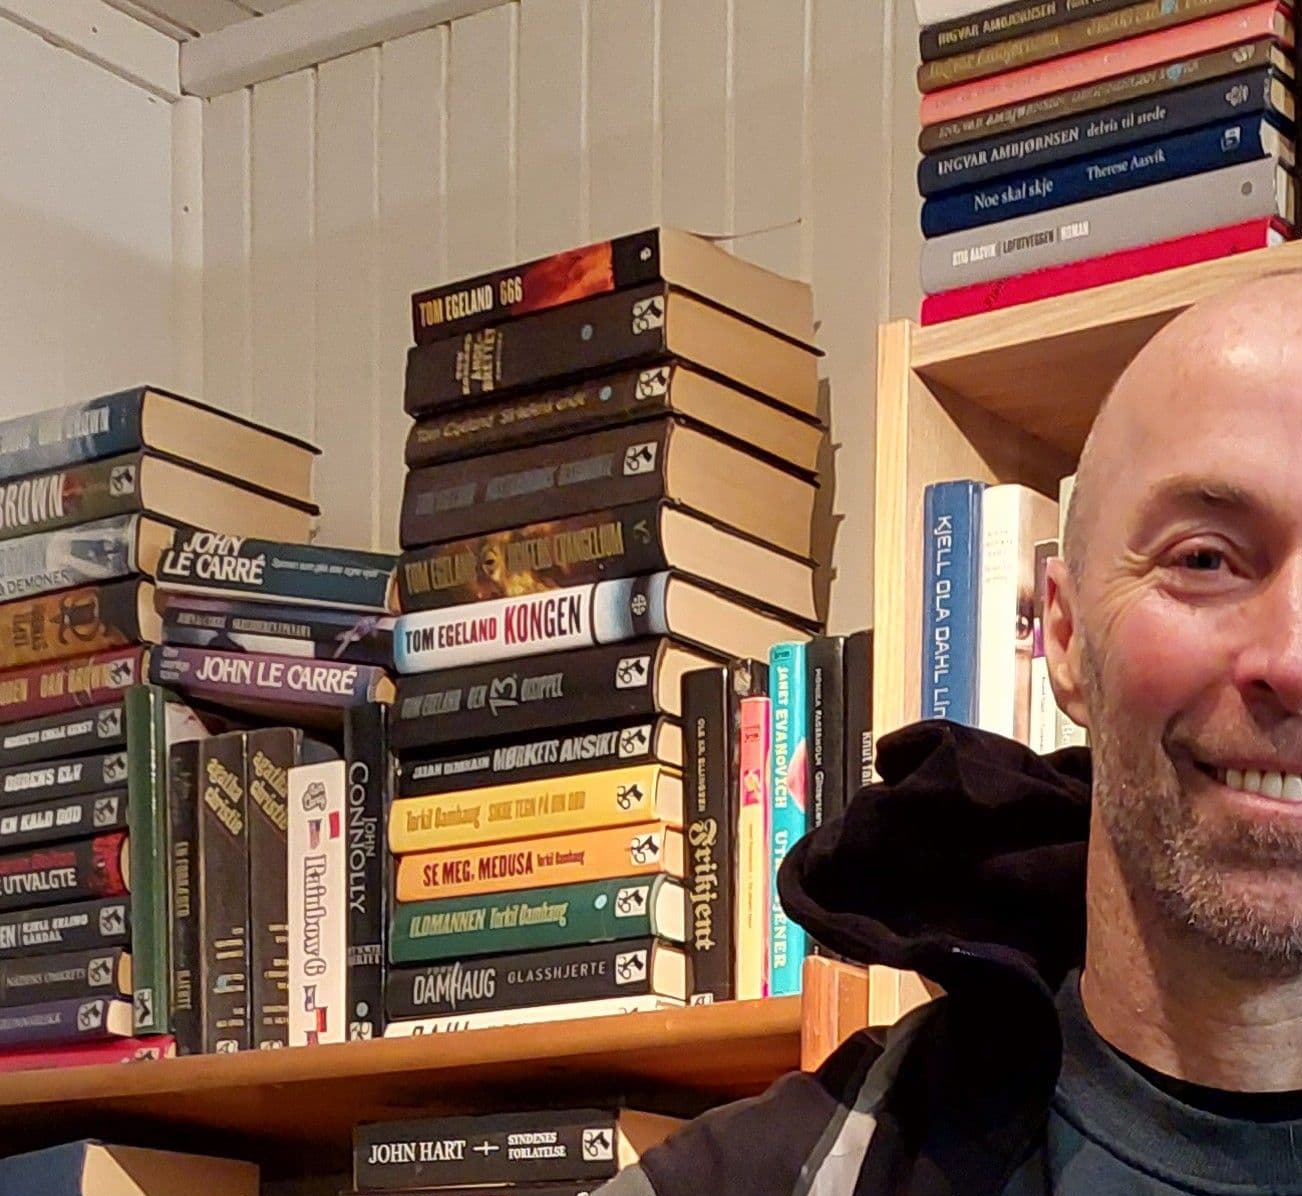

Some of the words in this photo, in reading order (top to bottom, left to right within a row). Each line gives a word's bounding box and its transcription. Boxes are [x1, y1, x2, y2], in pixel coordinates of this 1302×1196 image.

[938, 149, 988, 176] INGVAR
[990, 126, 1080, 163] AMBJØRNSEN
[1086, 119, 1118, 138] delvis
[1121, 113, 1135, 132] til
[973, 193, 1000, 213] Noe
[1000, 183, 1025, 205] skal
[1024, 177, 1054, 201] skje
[1086, 160, 1129, 183] Therese
[1130, 148, 1167, 174] Aasvik
[418, 300, 444, 328] TOM
[444, 284, 494, 319] EGELAND
[500, 276, 523, 307] 666
[183, 533, 247, 556] JOHN
[934, 515, 953, 577] KJELL
[163, 550, 194, 576] LE
[195, 552, 266, 584] CARRÉ
[935, 579, 951, 623] OLA
[405, 626, 434, 655] TOM
[437, 616, 498, 649] EGELAND
[503, 593, 583, 646] KONGEN
[196, 656, 253, 683] JOHN
[257, 661, 284, 687] LE
[286, 664, 359, 696] CARRÉ
[934, 628, 951, 684] DAHL
[492, 738, 558, 773] MØRKETS
[559, 731, 620, 764] ANSIKT
[348, 761, 369, 916] CONNOLLY
[363, 816, 377, 858] JOHN
[3, 867, 78, 896] UTVALGTE
[368, 1143, 417, 1165] JOHN
[420, 1139, 467, 1162] HART
